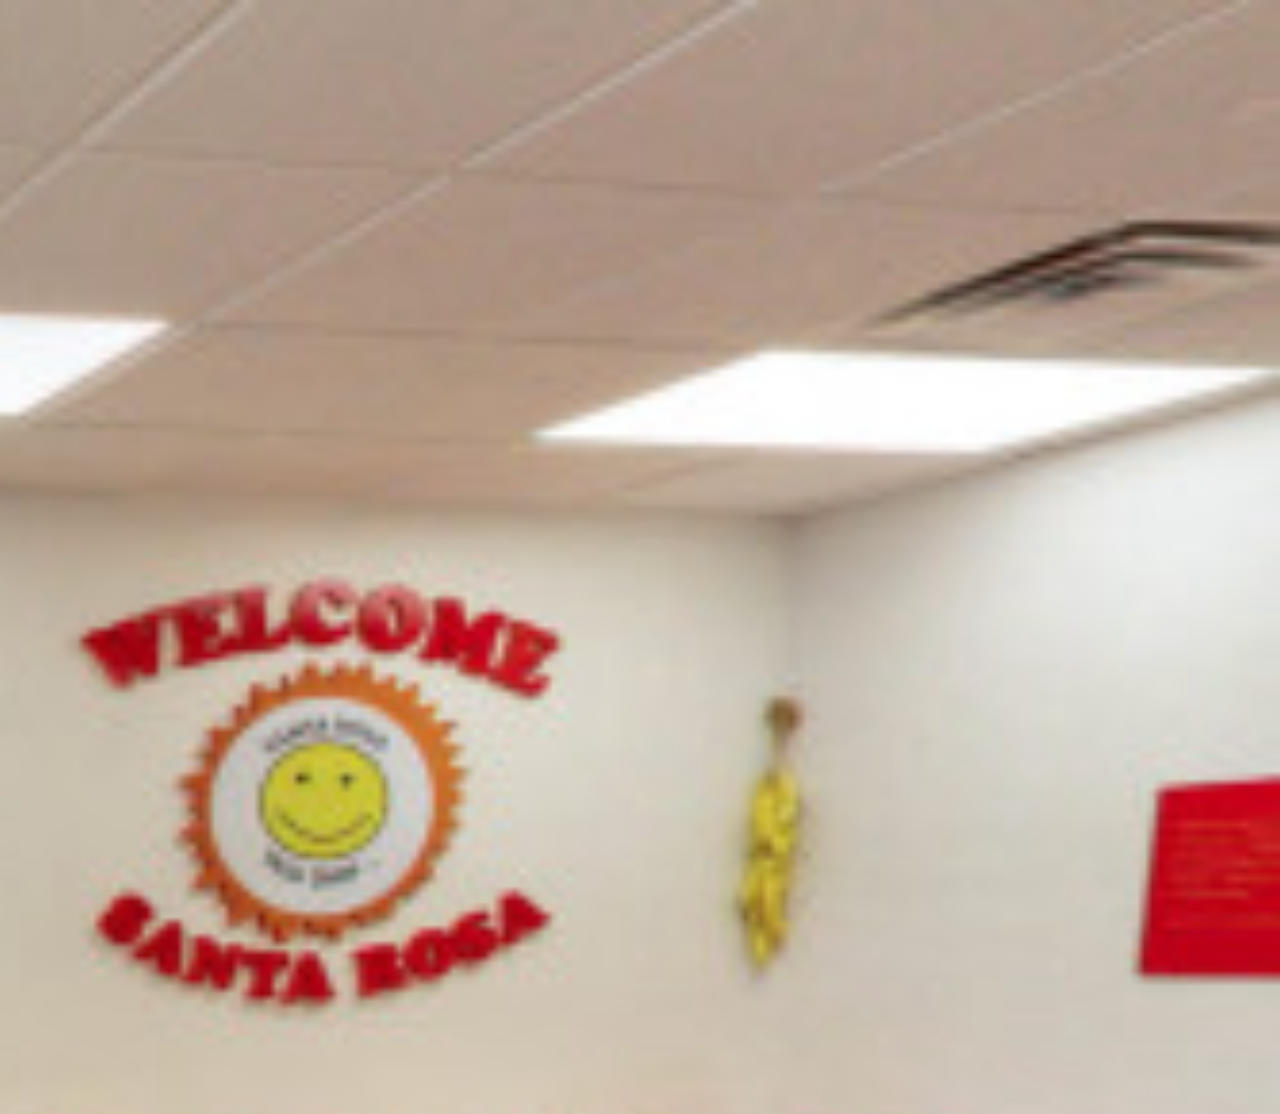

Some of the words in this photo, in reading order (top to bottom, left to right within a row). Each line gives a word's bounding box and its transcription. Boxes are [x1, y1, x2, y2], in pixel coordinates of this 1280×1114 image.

[82, 578, 558, 697] WELCOME
[96, 891, 336, 1004] SANTA
[353, 889, 550, 998] ROSA
